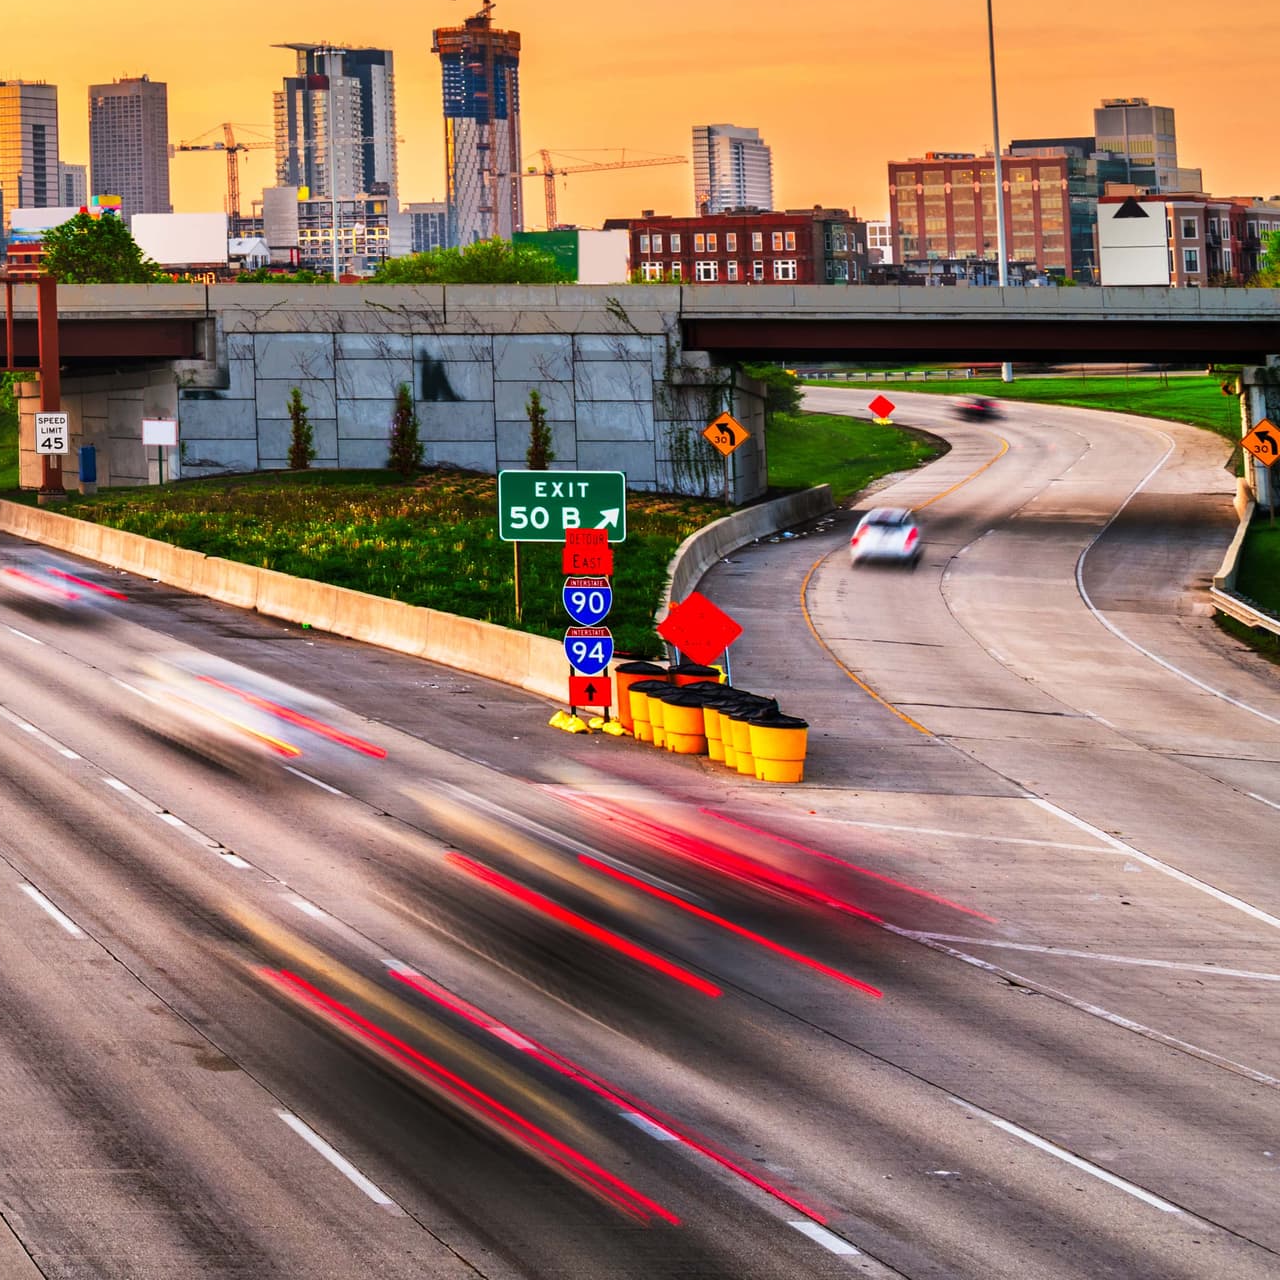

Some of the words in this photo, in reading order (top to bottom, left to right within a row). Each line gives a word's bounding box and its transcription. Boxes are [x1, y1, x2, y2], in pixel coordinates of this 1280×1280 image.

[41, 437, 64, 449] 45
[1254, 445, 1268, 453] 30
[535, 482, 589, 497] EXIT
[510, 506, 549, 529] 50
[561, 507, 580, 529] B
[569, 534, 604, 544] DETOUR
[571, 591, 604, 614] 90
[572, 641, 604, 663] 94
